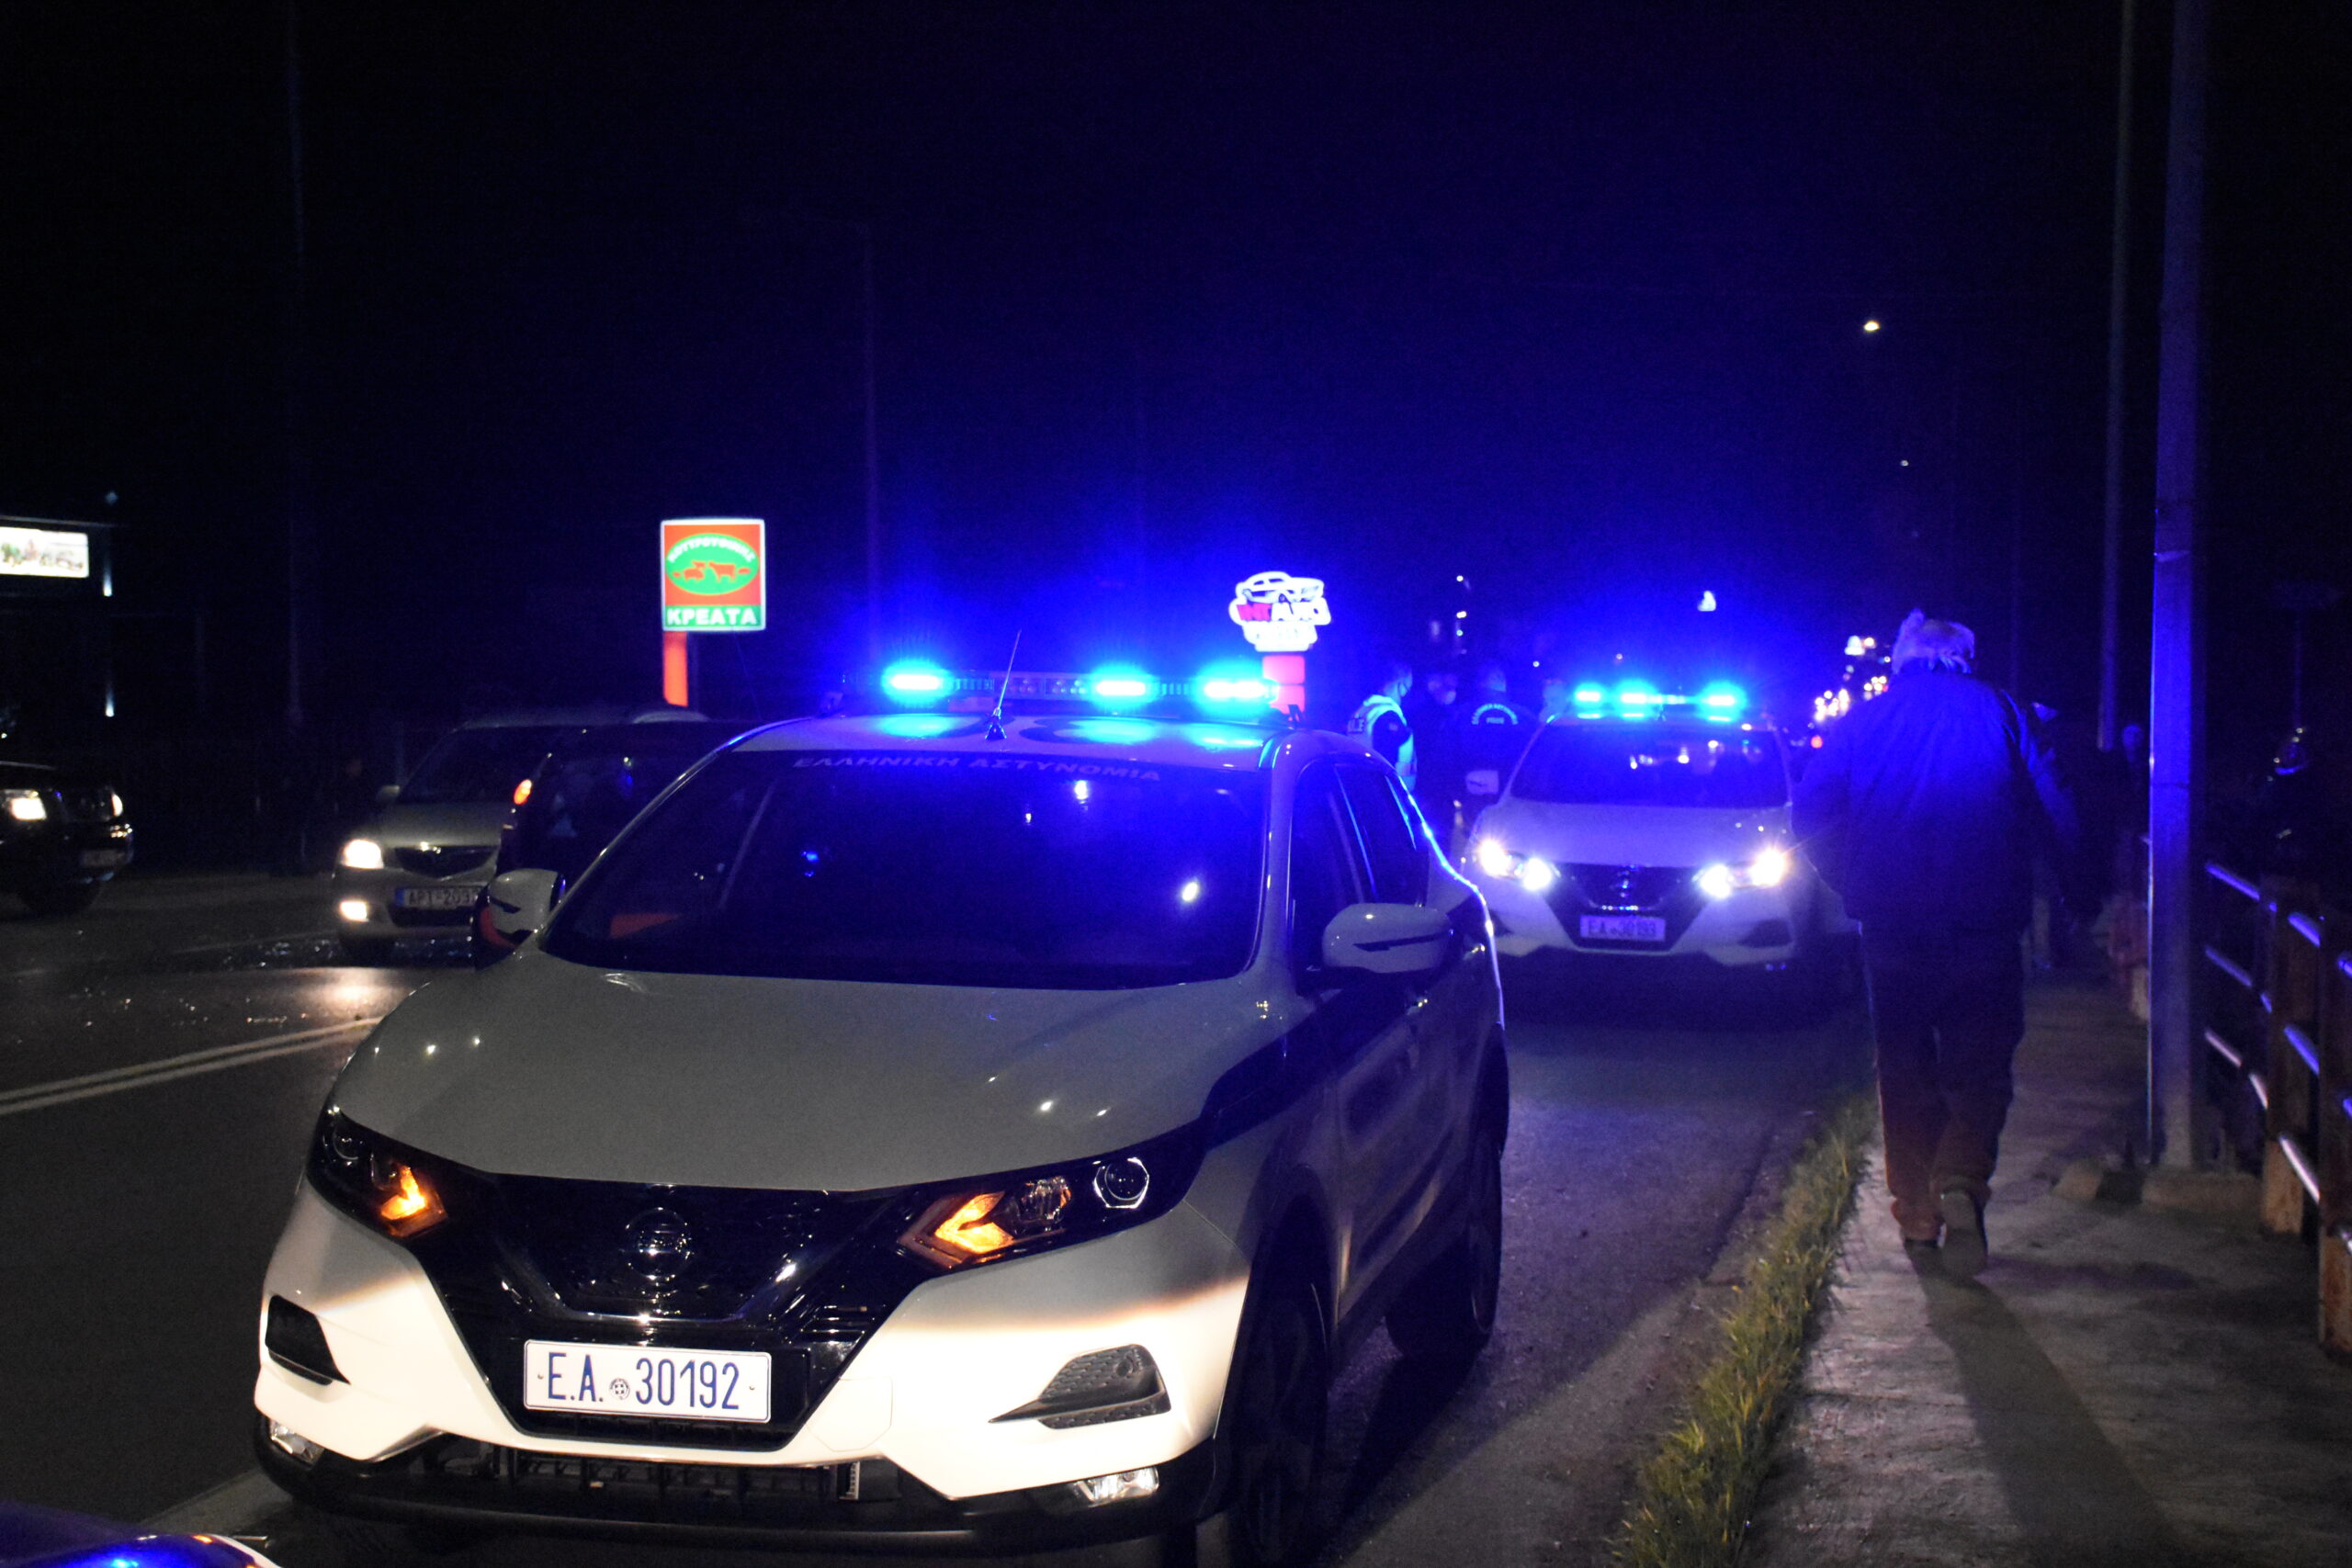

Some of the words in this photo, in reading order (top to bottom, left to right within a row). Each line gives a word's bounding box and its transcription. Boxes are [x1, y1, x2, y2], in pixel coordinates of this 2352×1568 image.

[667, 608, 757, 626] ΚΡΕΑΤΑ
[793, 756, 959, 768] ΕΛΛΗΝΙΚΗ
[968, 759, 1160, 781] ΑΣΤΥΝΟΜΙΑ
[548, 1351, 604, 1403] E.A.
[635, 1357, 741, 1410] 30192
